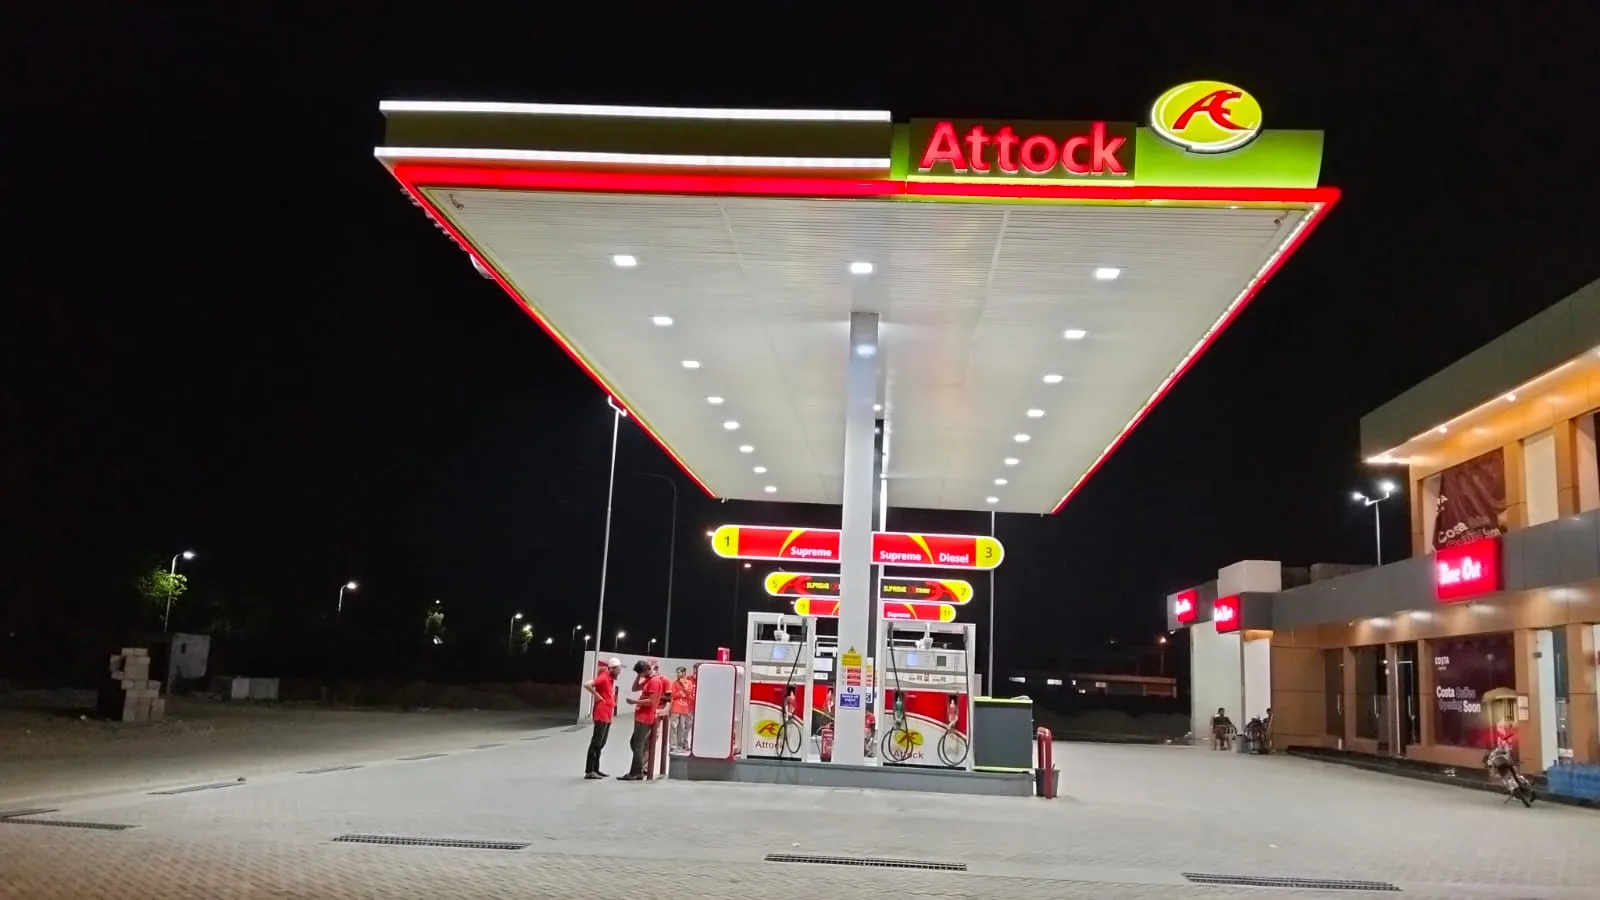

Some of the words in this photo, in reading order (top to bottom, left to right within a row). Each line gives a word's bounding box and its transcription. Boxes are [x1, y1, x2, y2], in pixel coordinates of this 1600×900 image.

[918, 121, 1128, 176] Attock
[725, 536, 730, 547] 1
[790, 546, 833, 558] Supreme
[880, 550, 922, 562] Supreme
[939, 553, 969, 563] Diesel
[985, 547, 993, 558] 3
[1436, 686, 1455, 698] Costa
[1463, 700, 1481, 712] Soon
[894, 750, 924, 760] Atck
